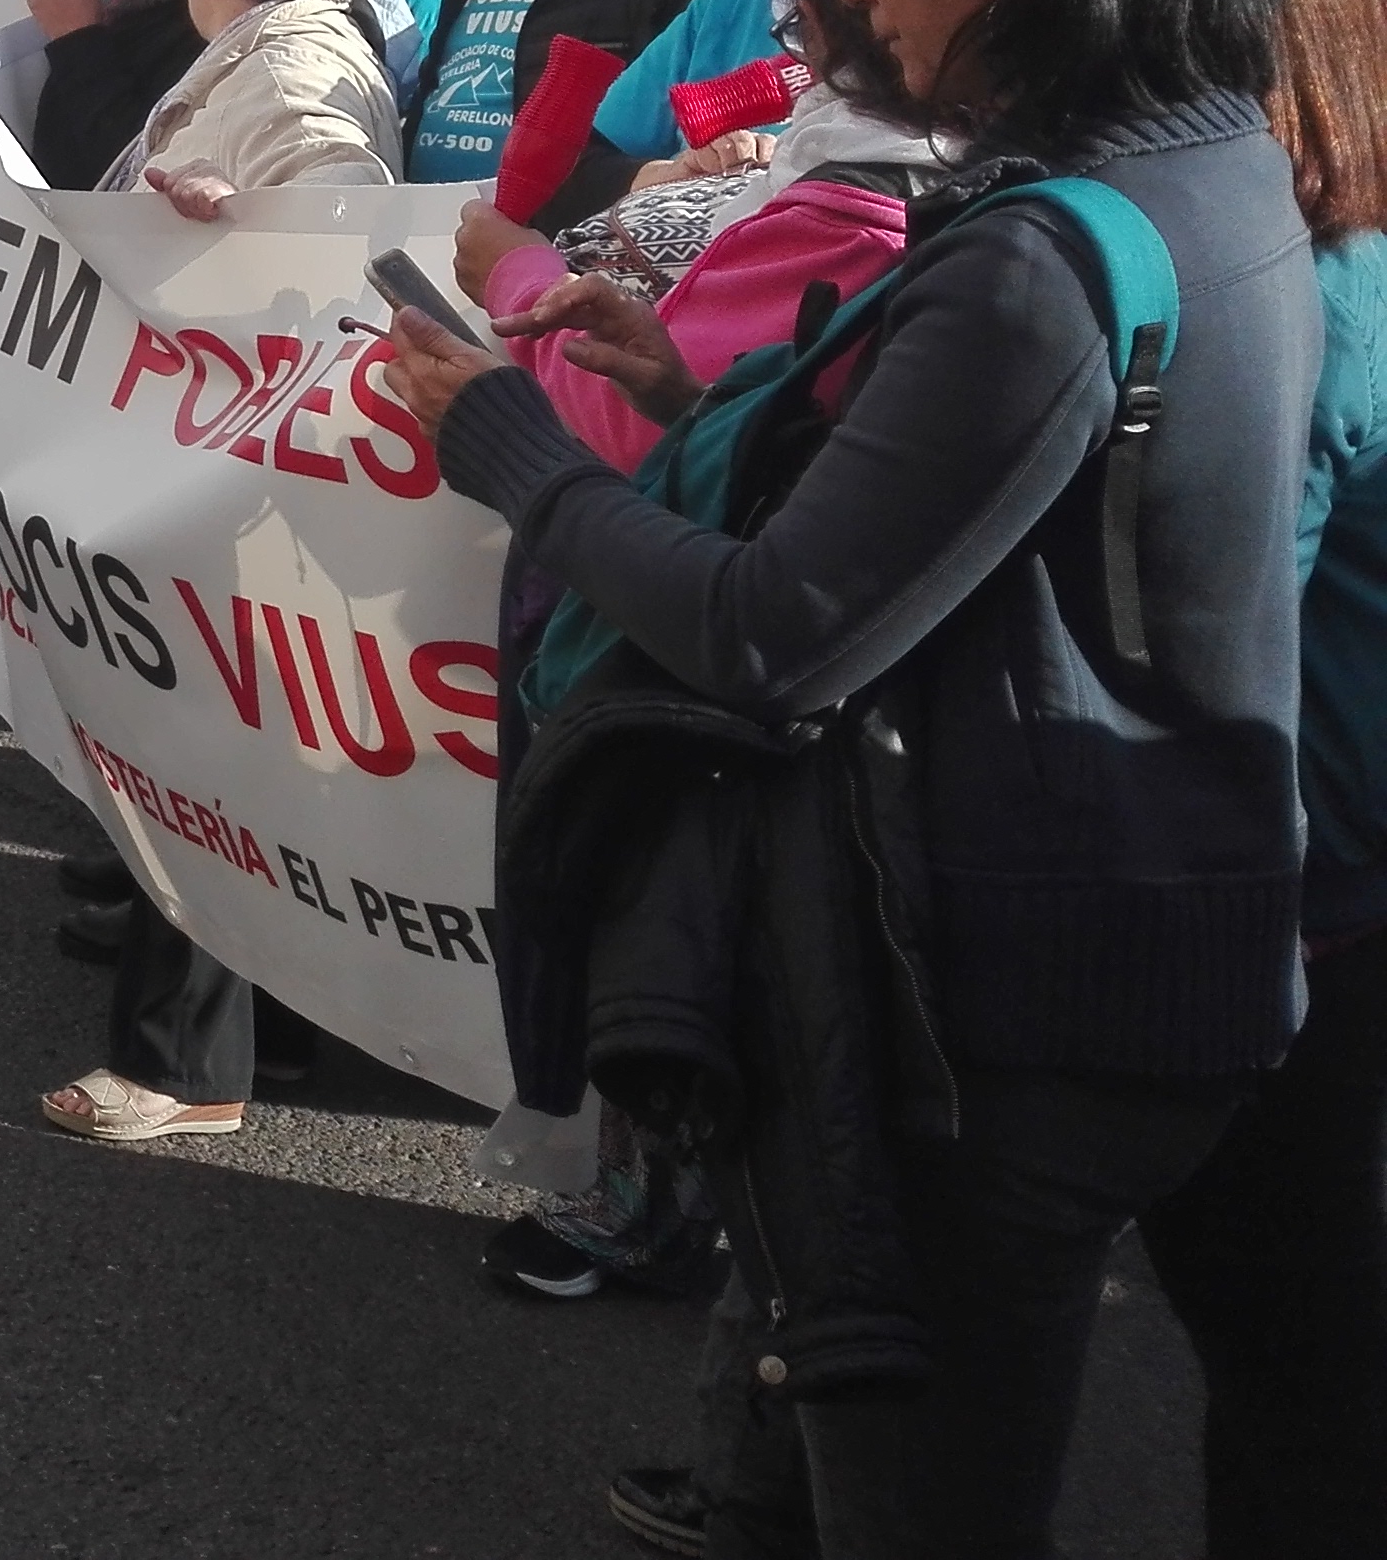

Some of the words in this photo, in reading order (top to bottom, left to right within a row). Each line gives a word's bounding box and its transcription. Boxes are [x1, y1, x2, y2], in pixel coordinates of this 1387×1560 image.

[500, 47, 516, 62] CO
[419, 132, 493, 152] CV-500
[276, 843, 348, 925] EL
